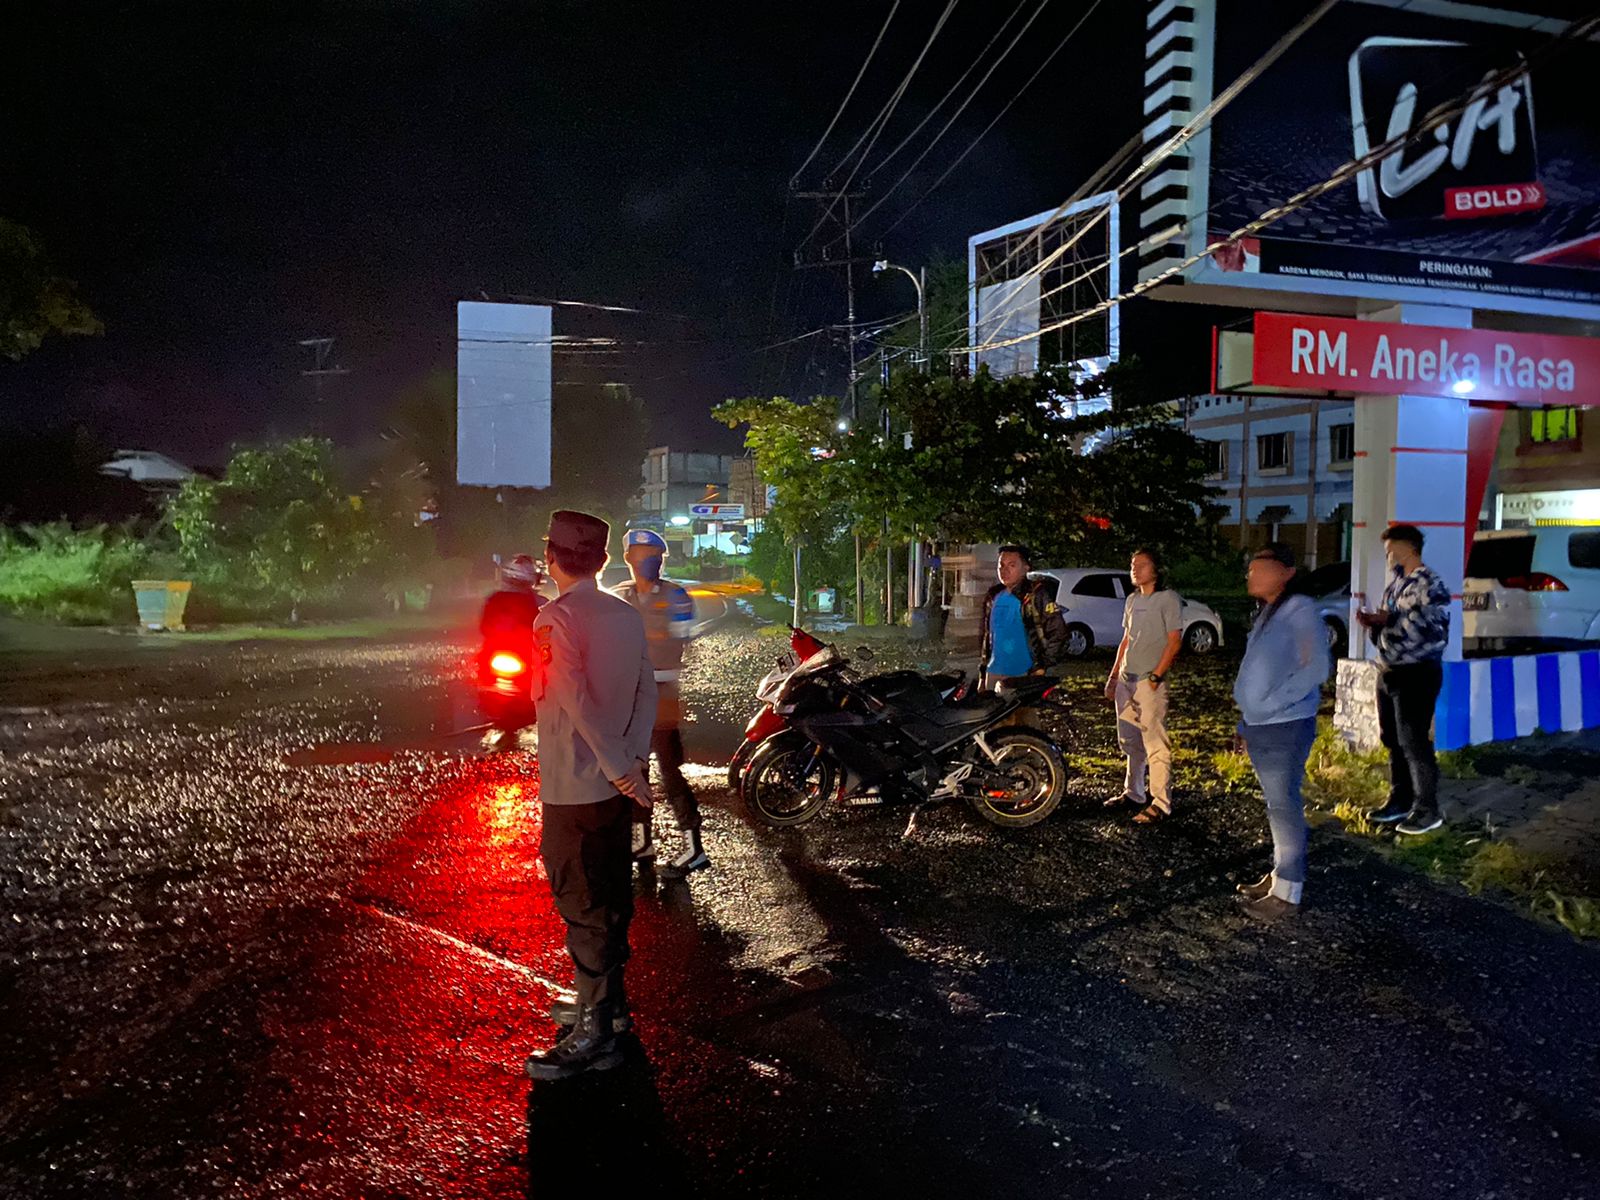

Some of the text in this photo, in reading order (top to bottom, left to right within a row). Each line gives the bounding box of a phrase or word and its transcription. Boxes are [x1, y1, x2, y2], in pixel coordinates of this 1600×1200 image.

[1455, 188, 1523, 211] BOLD
[1419, 260, 1493, 278] PERINGATAN:
[1291, 328, 1576, 393] RM. Aneka Rasa
